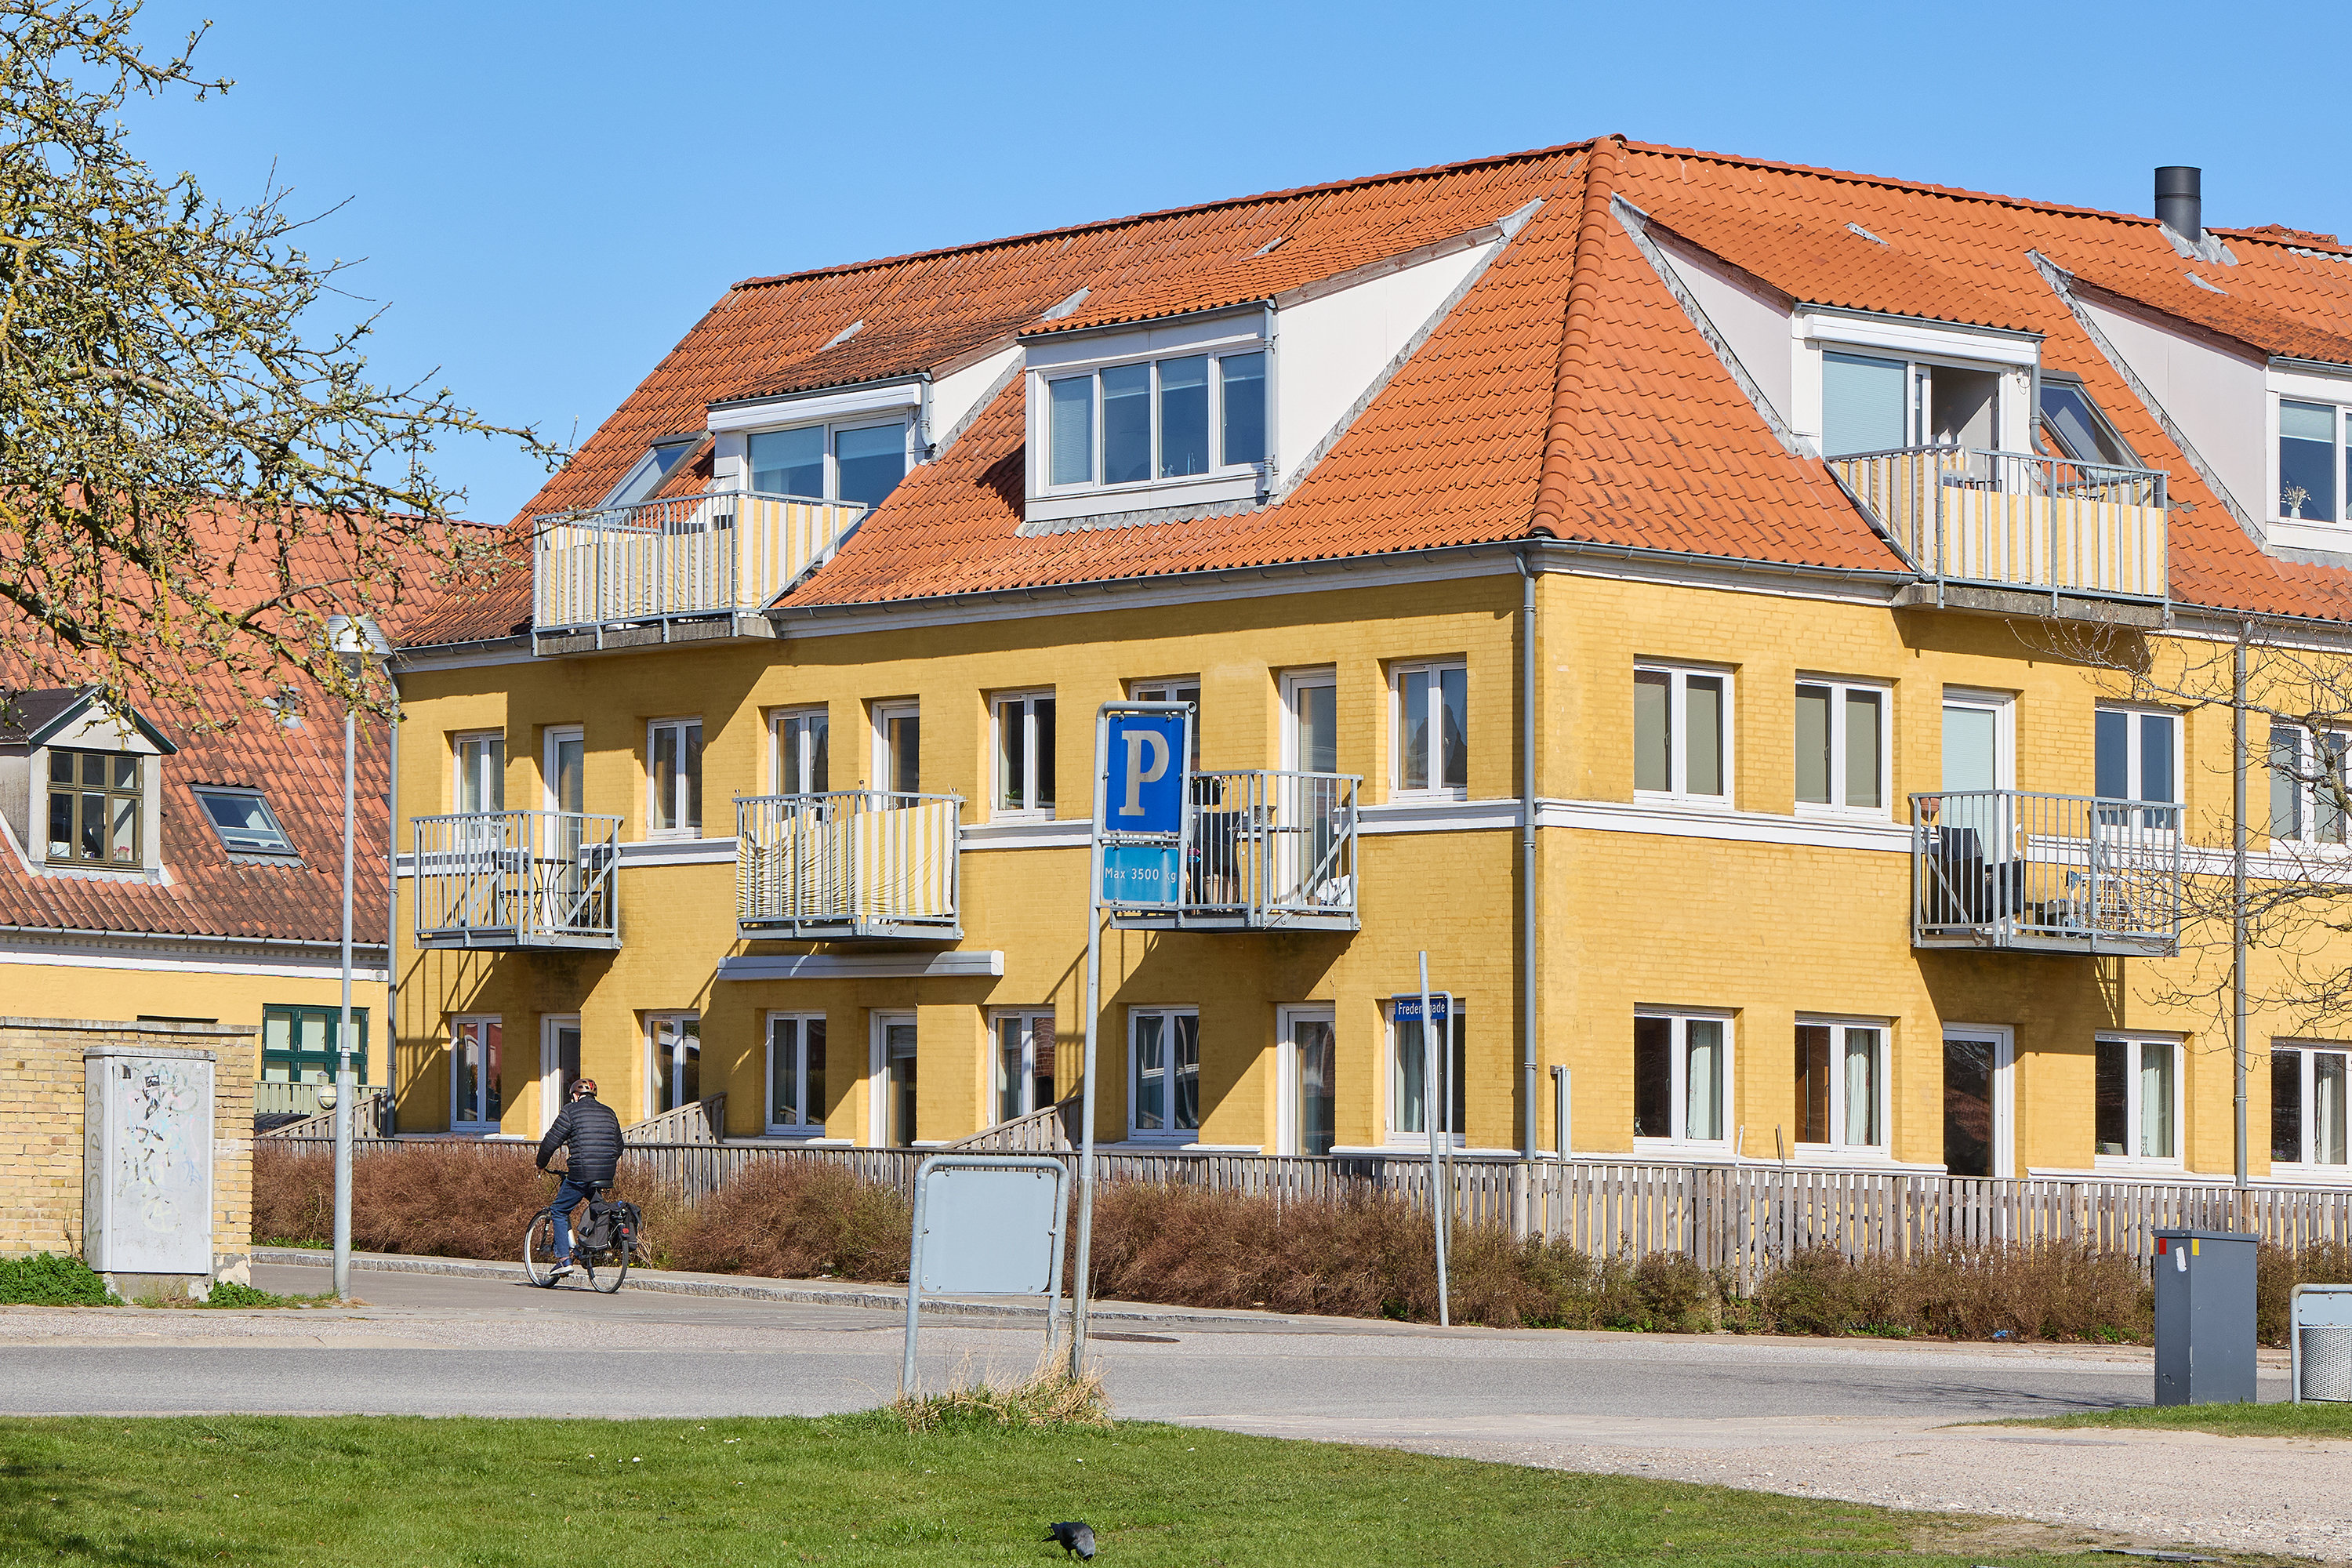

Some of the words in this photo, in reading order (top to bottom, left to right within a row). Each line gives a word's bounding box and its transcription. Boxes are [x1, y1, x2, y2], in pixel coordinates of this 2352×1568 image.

[1119, 730, 1170, 816] P
[1105, 867, 1126, 879] Max
[1131, 868, 1160, 880] 3500
[1165, 870, 1177, 884] kg
